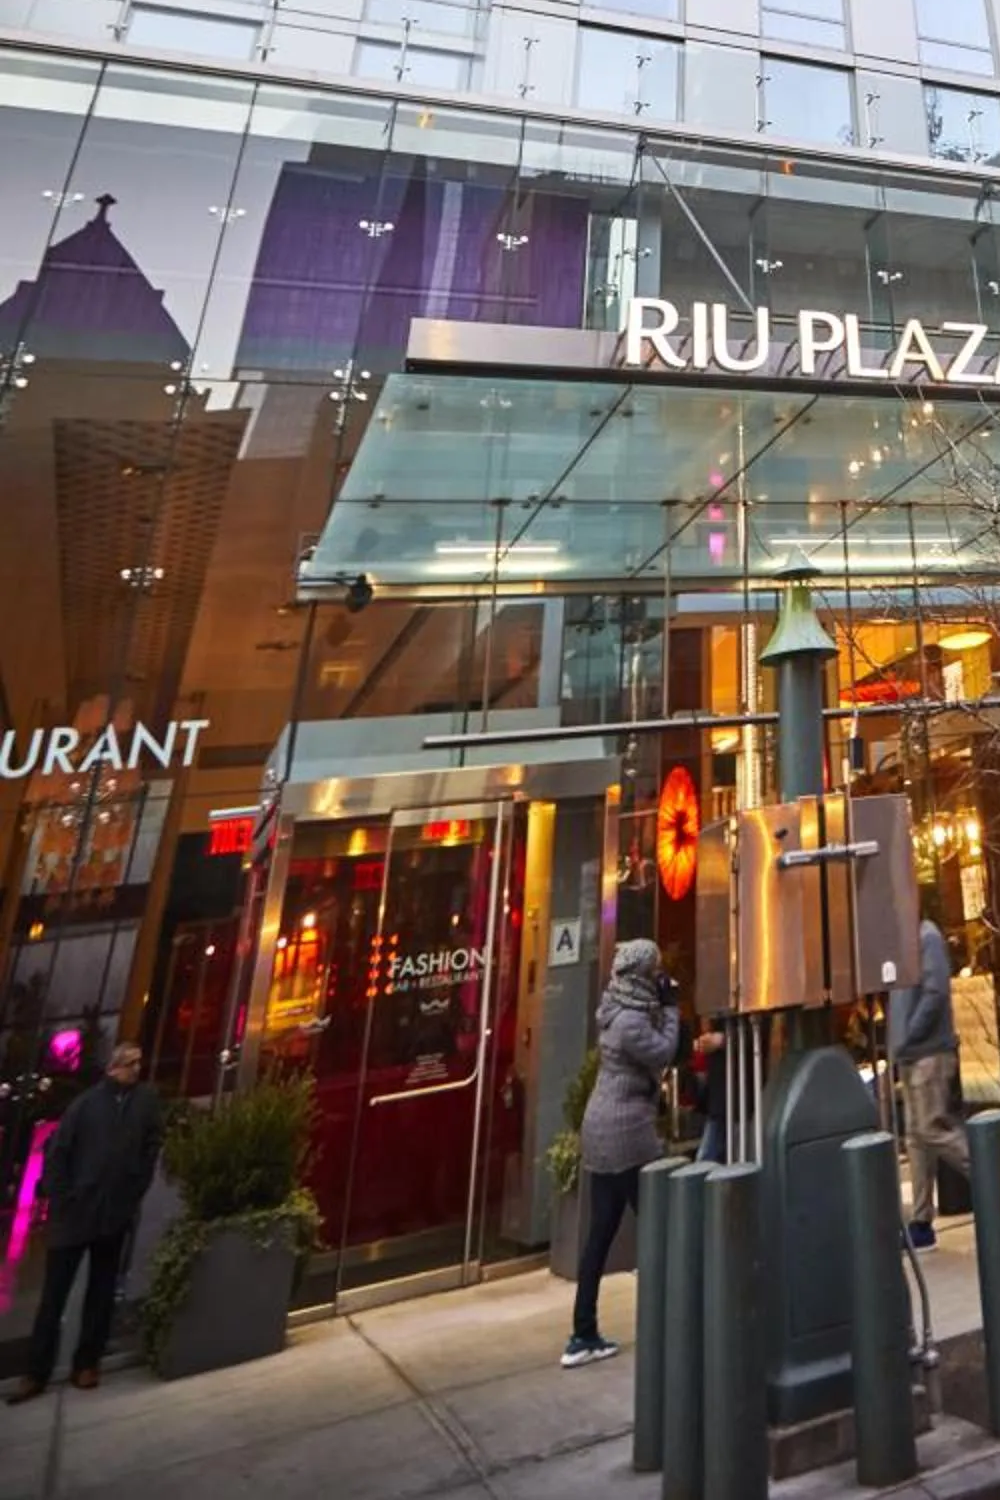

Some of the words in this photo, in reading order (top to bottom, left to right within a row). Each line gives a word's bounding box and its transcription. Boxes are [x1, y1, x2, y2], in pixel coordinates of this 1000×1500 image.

[625, 297, 770, 373] RIU
[0, 720, 210, 778] URANT
[556, 928, 573, 952] A
[391, 947, 490, 978] FASHION
